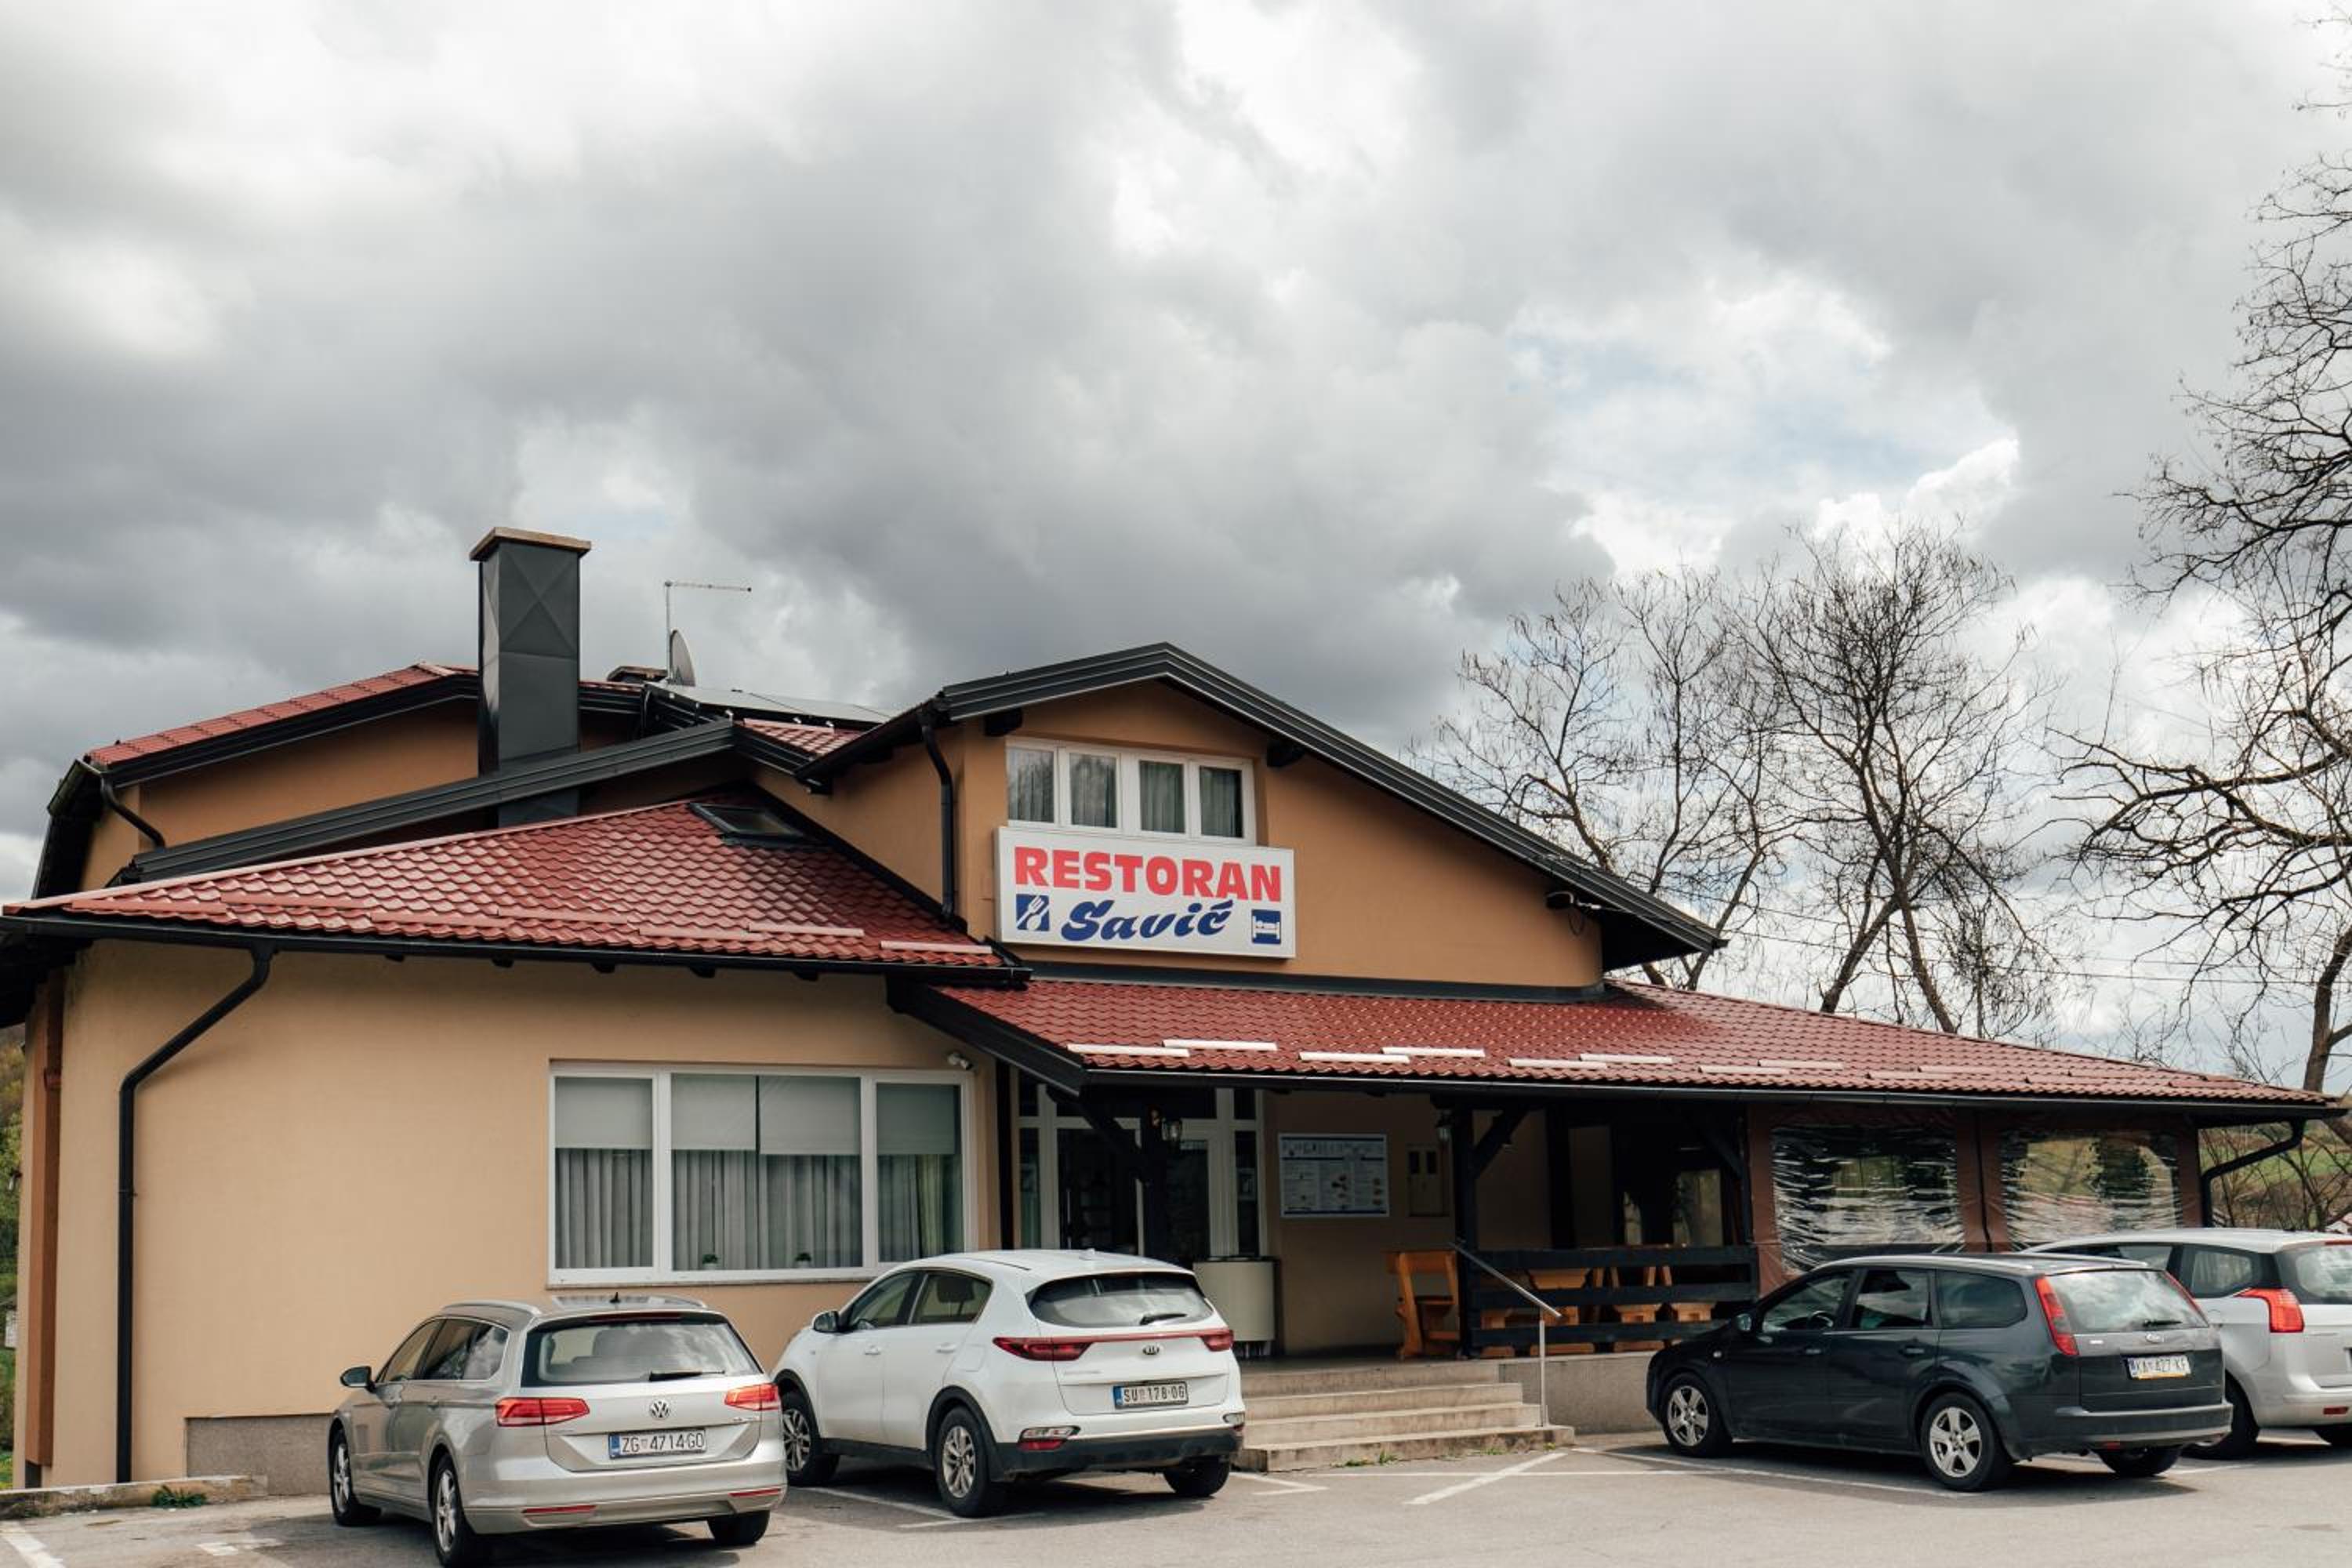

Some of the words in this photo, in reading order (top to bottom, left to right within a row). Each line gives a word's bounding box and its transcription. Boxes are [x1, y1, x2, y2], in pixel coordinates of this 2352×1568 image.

[1014, 846, 1282, 902] RESTORAN
[1061, 899, 1234, 942] Savić
[1123, 1388, 1138, 1403] SU
[622, 1436, 640, 1453] ZG
